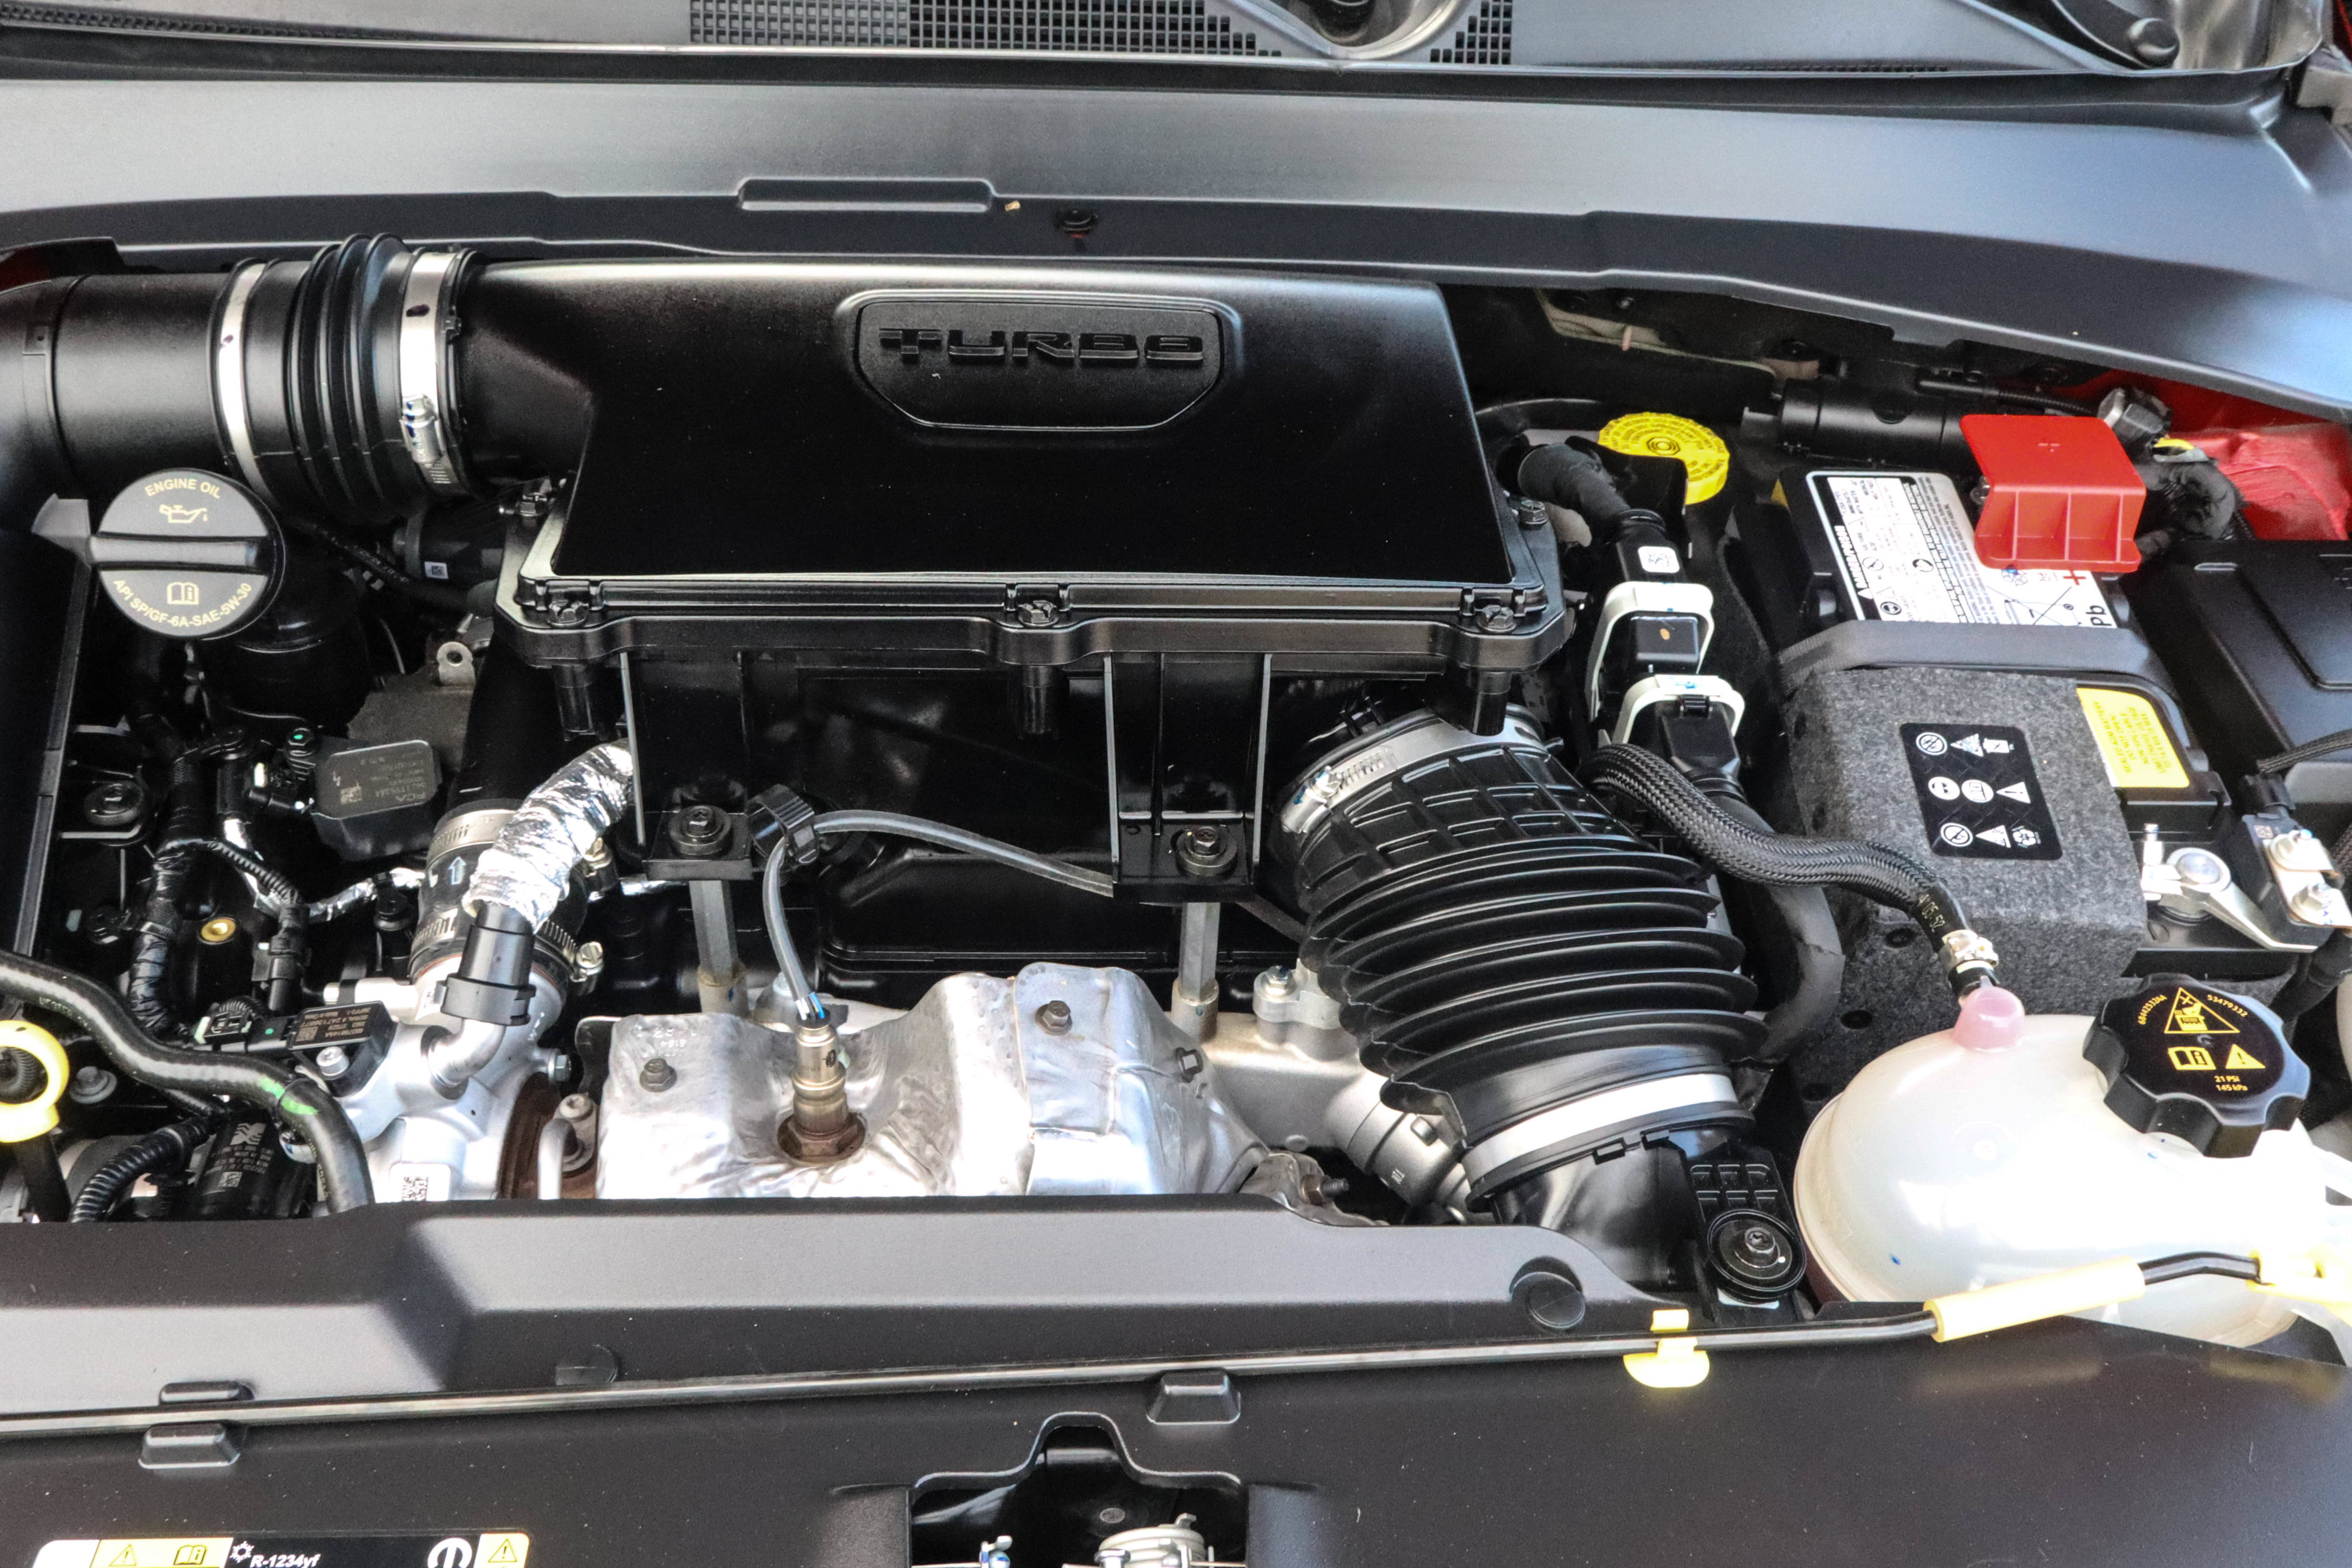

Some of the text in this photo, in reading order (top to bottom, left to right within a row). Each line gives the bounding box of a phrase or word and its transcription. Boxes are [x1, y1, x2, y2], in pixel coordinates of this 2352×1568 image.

[144, 478, 220, 499] ENGINE OIL
[114, 580, 134, 600] API
[2085, 605, 2112, 626] Pb
[2207, 994, 2248, 1017] 53479332
[250, 1554, 321, 1568] R-1234yf
